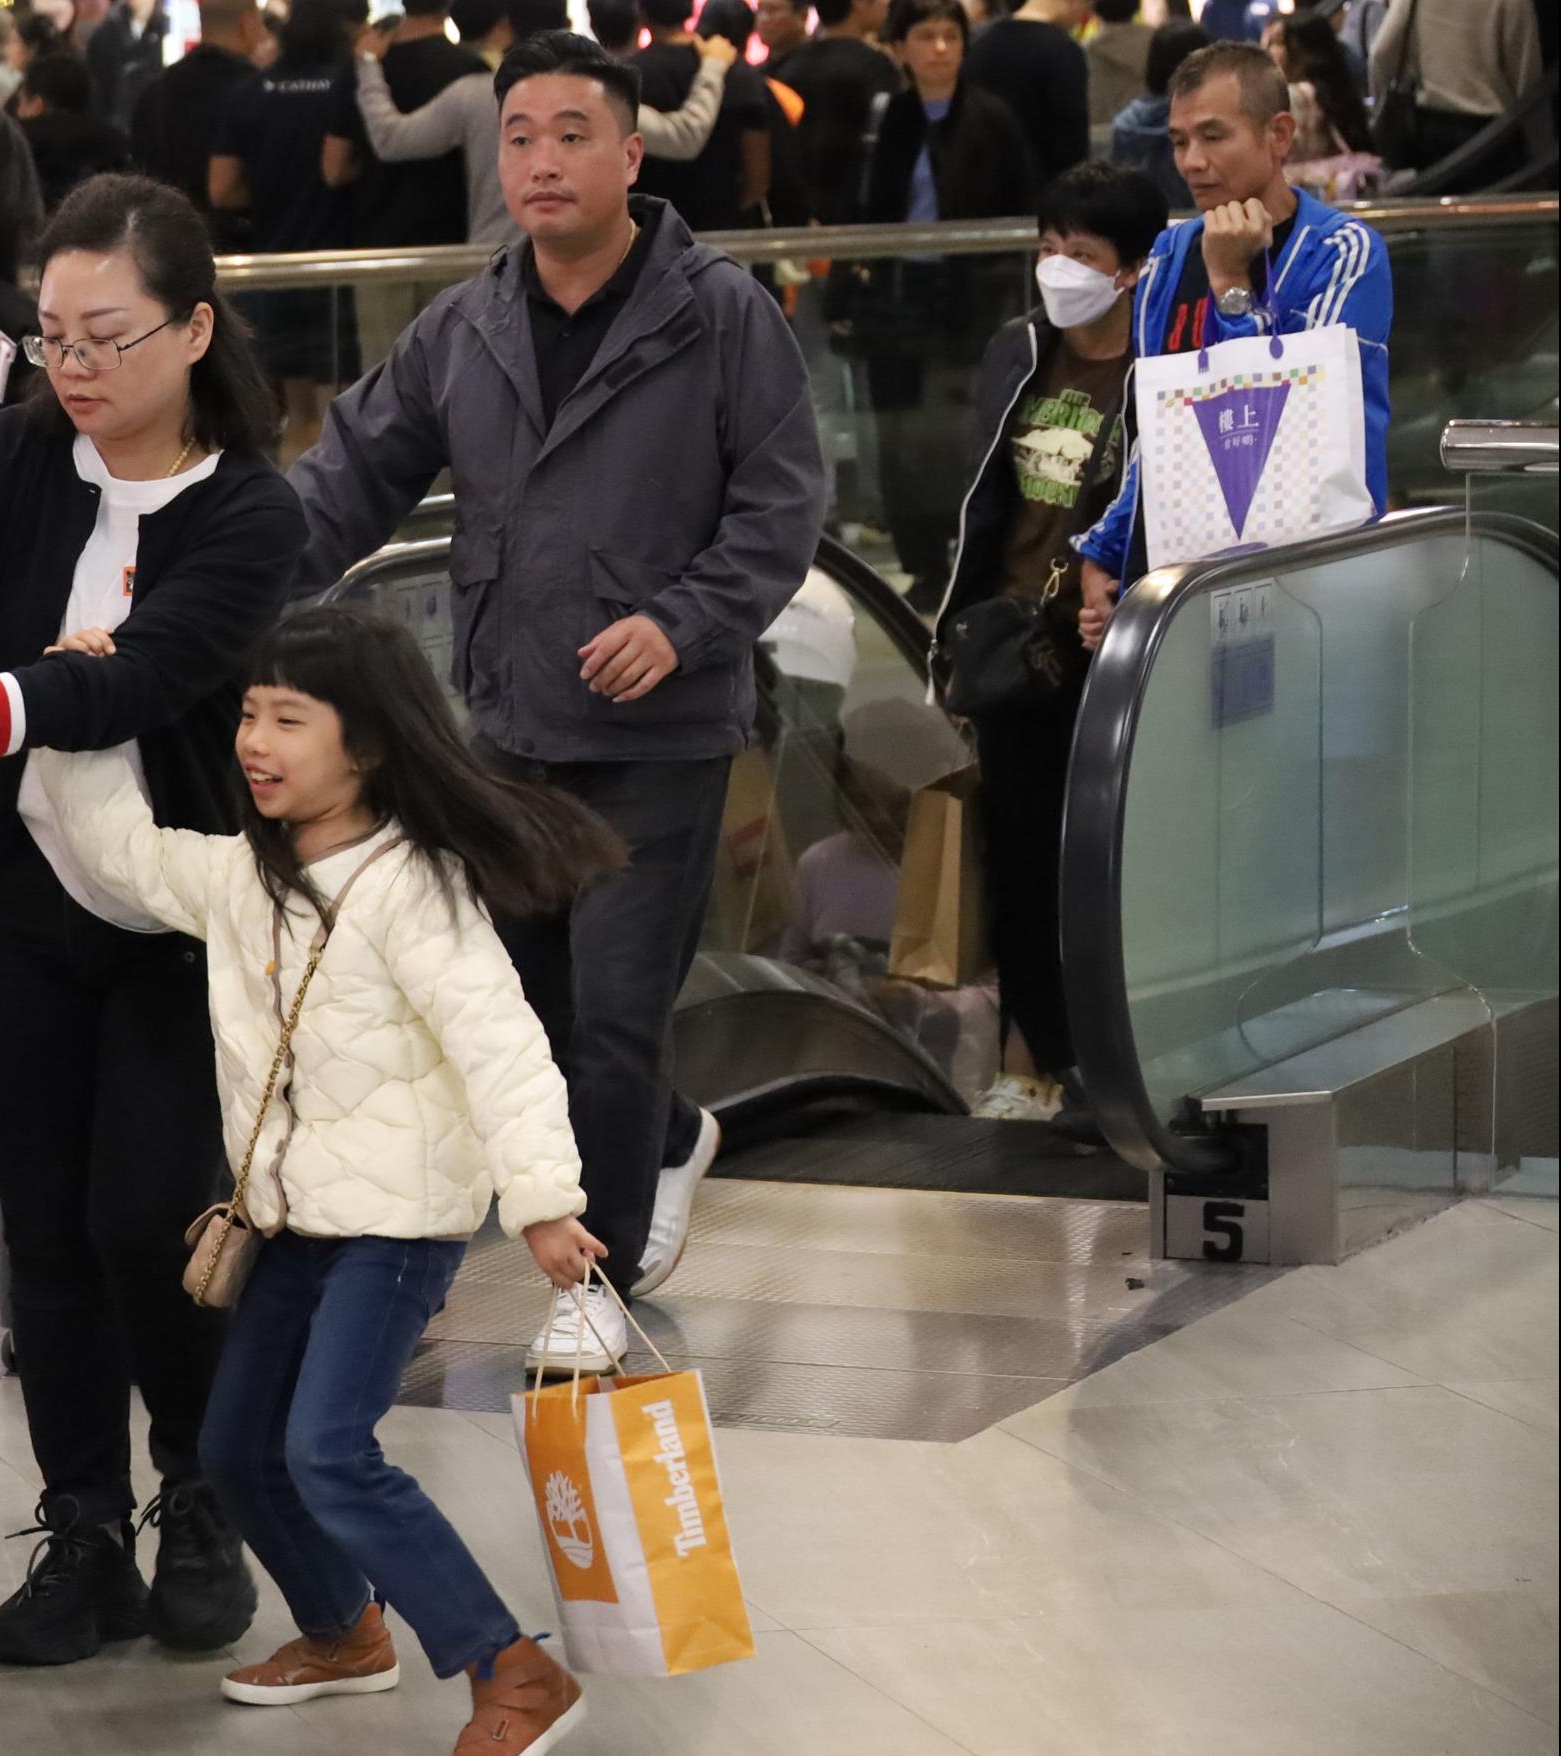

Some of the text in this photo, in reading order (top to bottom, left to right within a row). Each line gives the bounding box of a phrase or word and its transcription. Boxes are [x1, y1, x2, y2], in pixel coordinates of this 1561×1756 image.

[1218, 404, 1259, 434] 樓上
[1202, 1201, 1245, 1262] 5
[641, 1399, 707, 1557] Timberland
